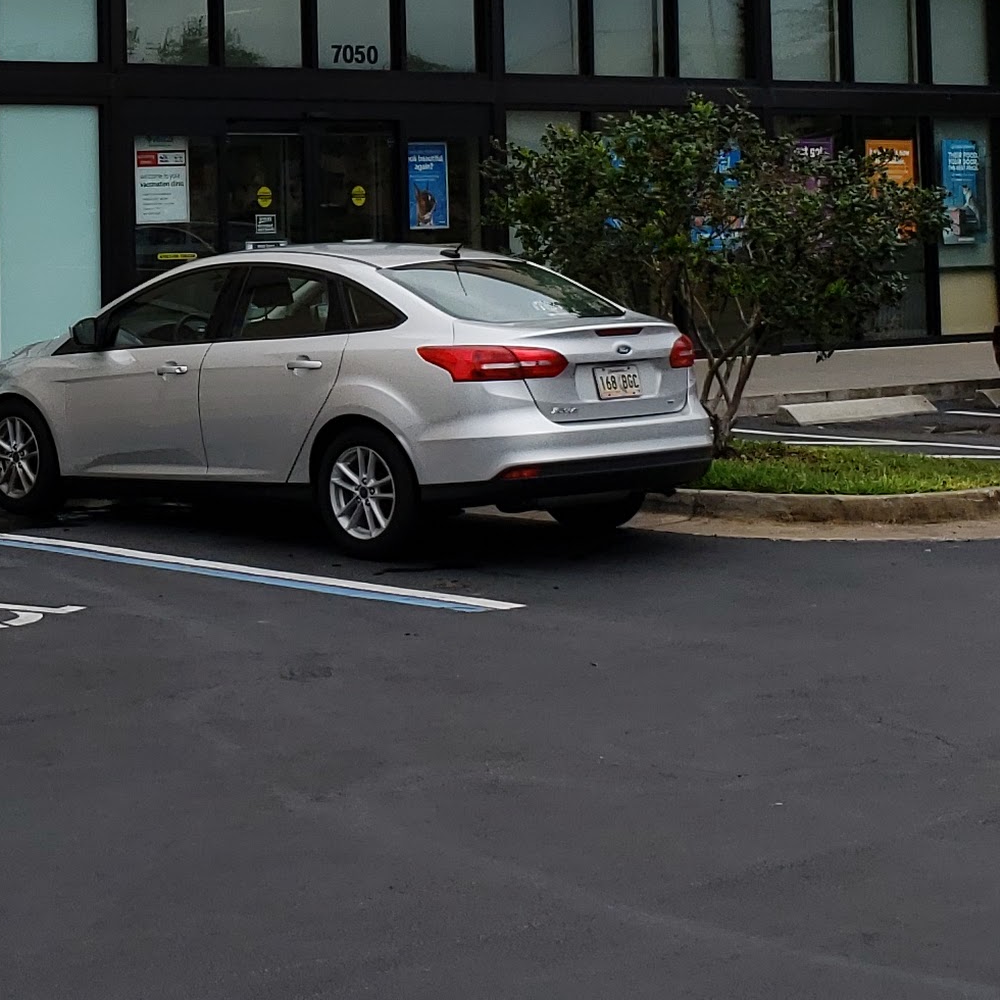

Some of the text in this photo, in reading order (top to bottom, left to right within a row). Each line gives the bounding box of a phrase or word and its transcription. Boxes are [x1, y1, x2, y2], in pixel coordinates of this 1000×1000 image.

[331, 45, 379, 64] 7050
[600, 374, 640, 391] 168 BGC
